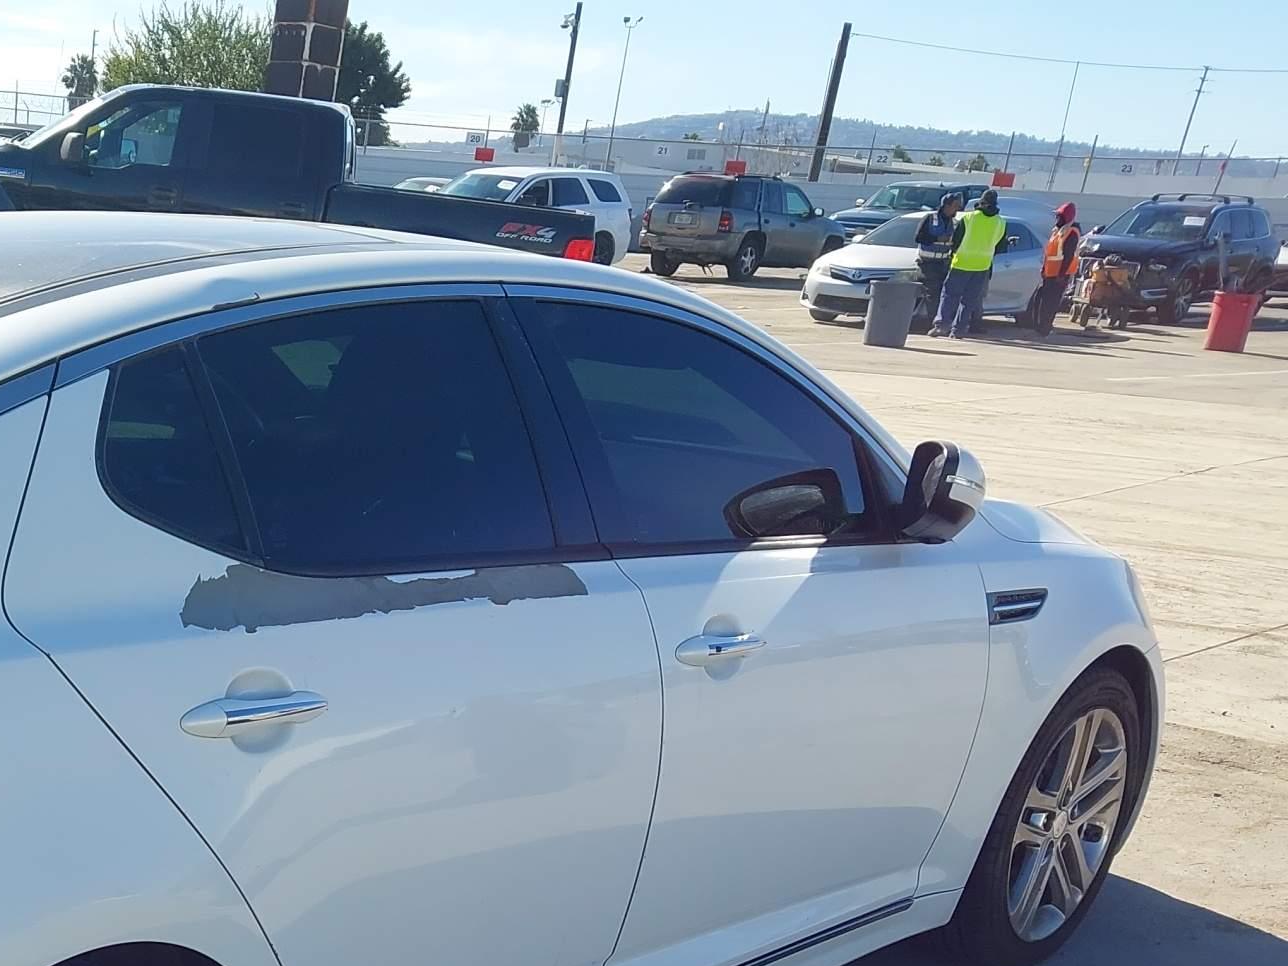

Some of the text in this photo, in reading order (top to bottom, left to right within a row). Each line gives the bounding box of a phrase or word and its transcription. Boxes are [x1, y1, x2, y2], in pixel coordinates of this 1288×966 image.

[470, 135, 481, 143] 20
[657, 146, 669, 155] 21
[876, 155, 889, 163] 22
[1121, 164, 1133, 173] 23
[520, 235, 553, 243] ROAD
